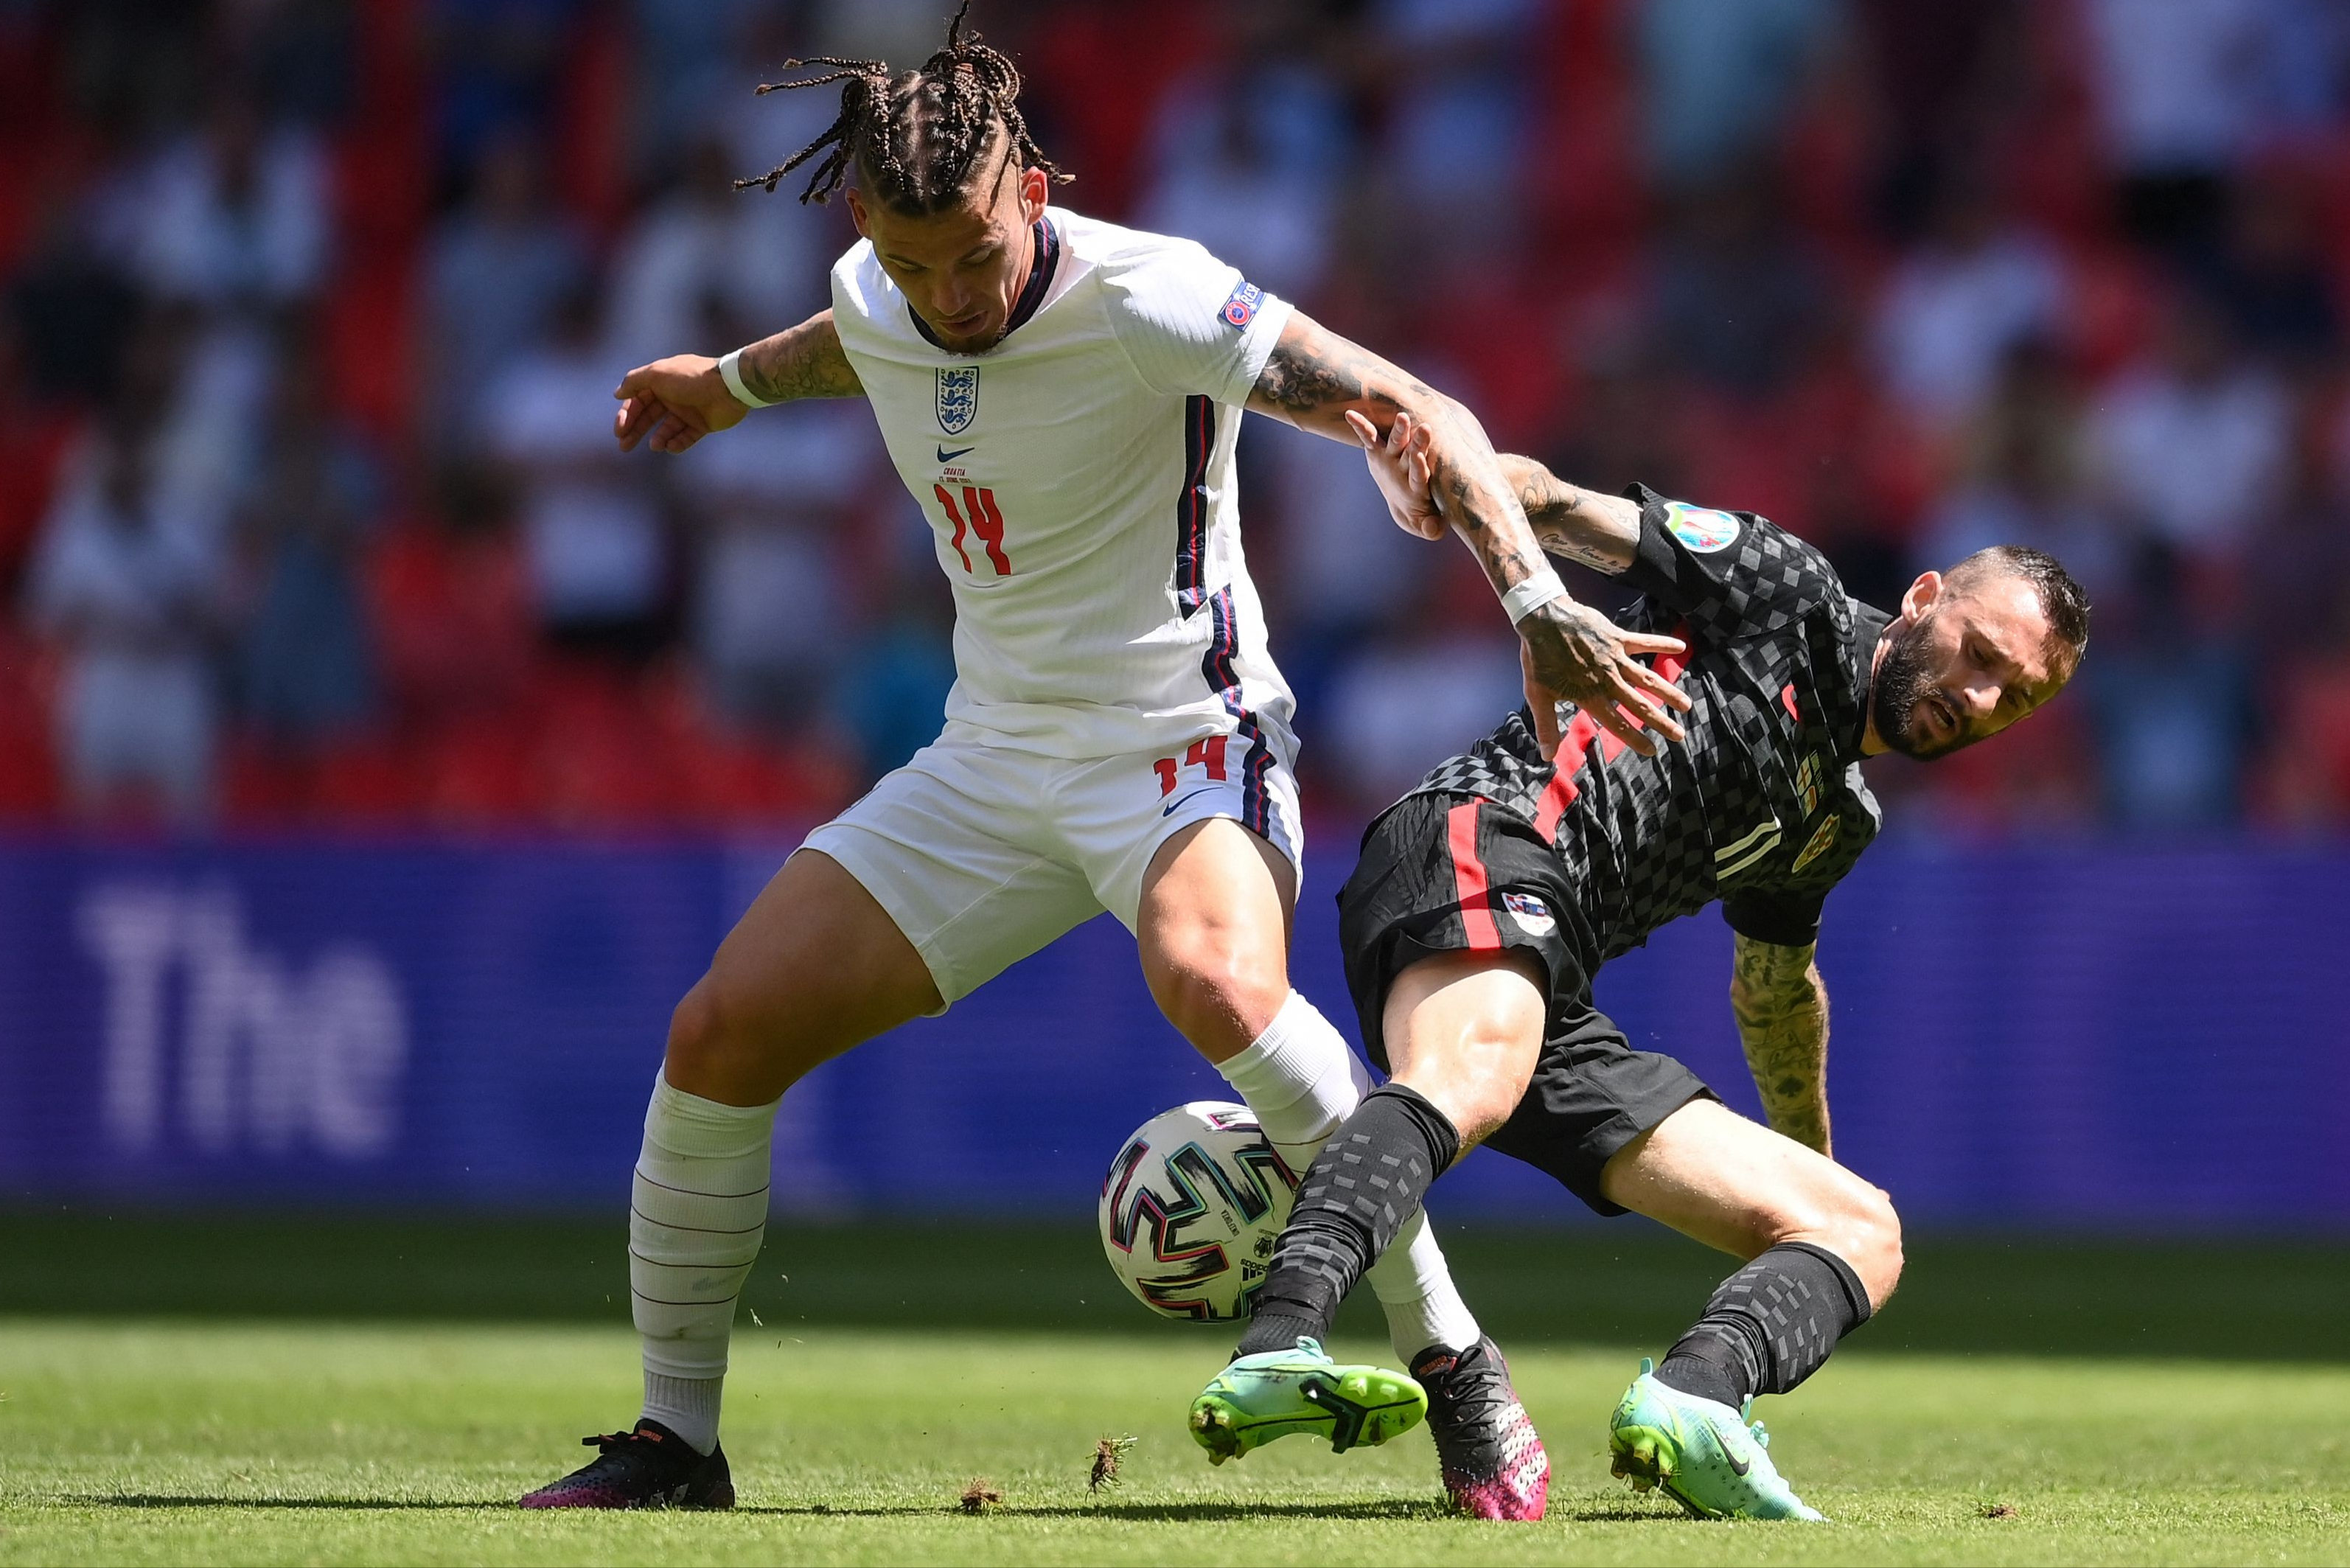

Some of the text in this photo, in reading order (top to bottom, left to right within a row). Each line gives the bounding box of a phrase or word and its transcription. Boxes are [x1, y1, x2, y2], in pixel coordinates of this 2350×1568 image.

[943, 467, 966, 476] CROATIA
[933, 484, 1012, 575] 14
[1153, 735, 1229, 802] 14
[1714, 815, 1782, 882] 11
[78, 885, 405, 1154] The
